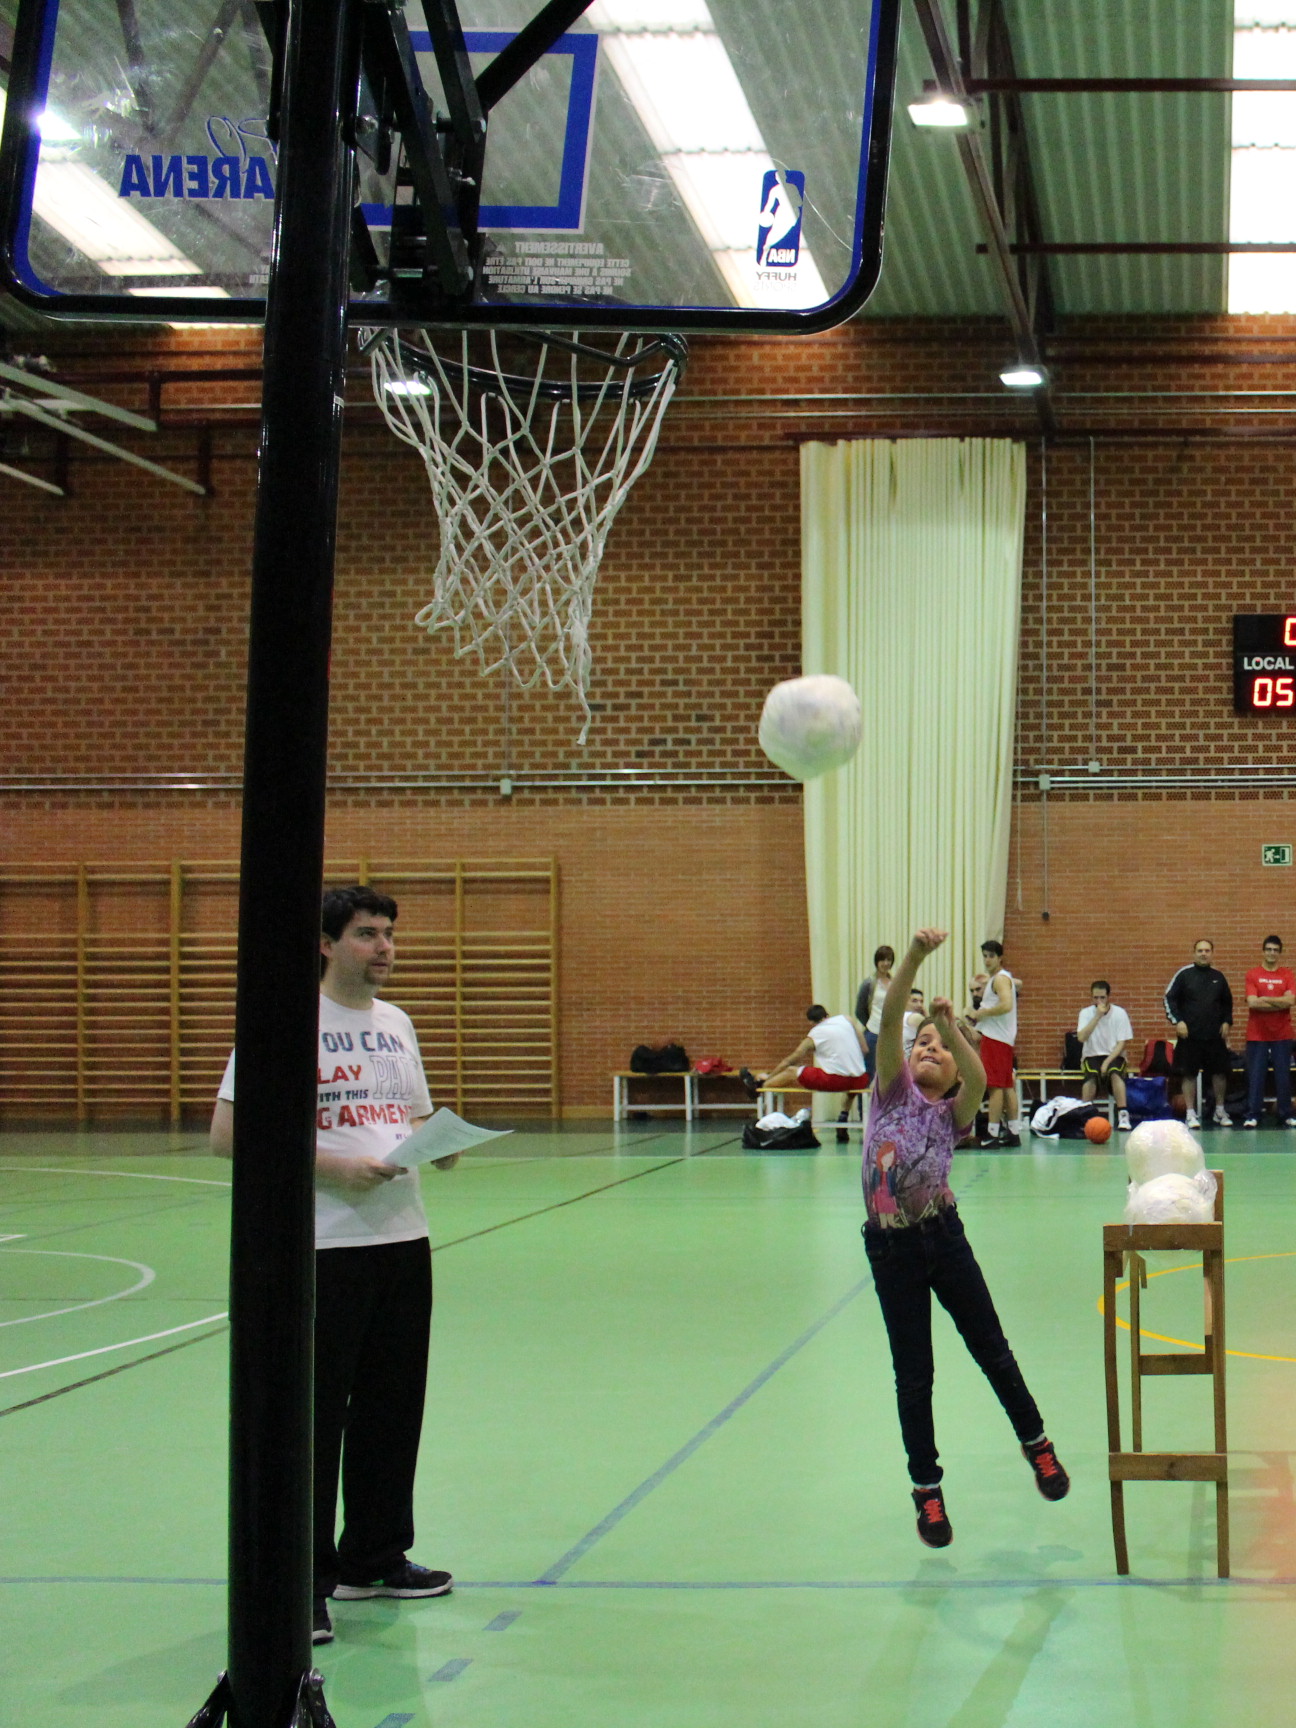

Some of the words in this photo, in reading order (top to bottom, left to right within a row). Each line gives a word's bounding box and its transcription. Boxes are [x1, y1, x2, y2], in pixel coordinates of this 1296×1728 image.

[1243, 656, 1295, 670] LOCAL
[1253, 677, 1294, 707] 05
[322, 1031, 354, 1053] OU
[361, 1031, 406, 1054] CAN
[317, 1064, 362, 1085] LAY
[318, 1091, 341, 1103] ITH
[345, 1089, 369, 1100] THIS
